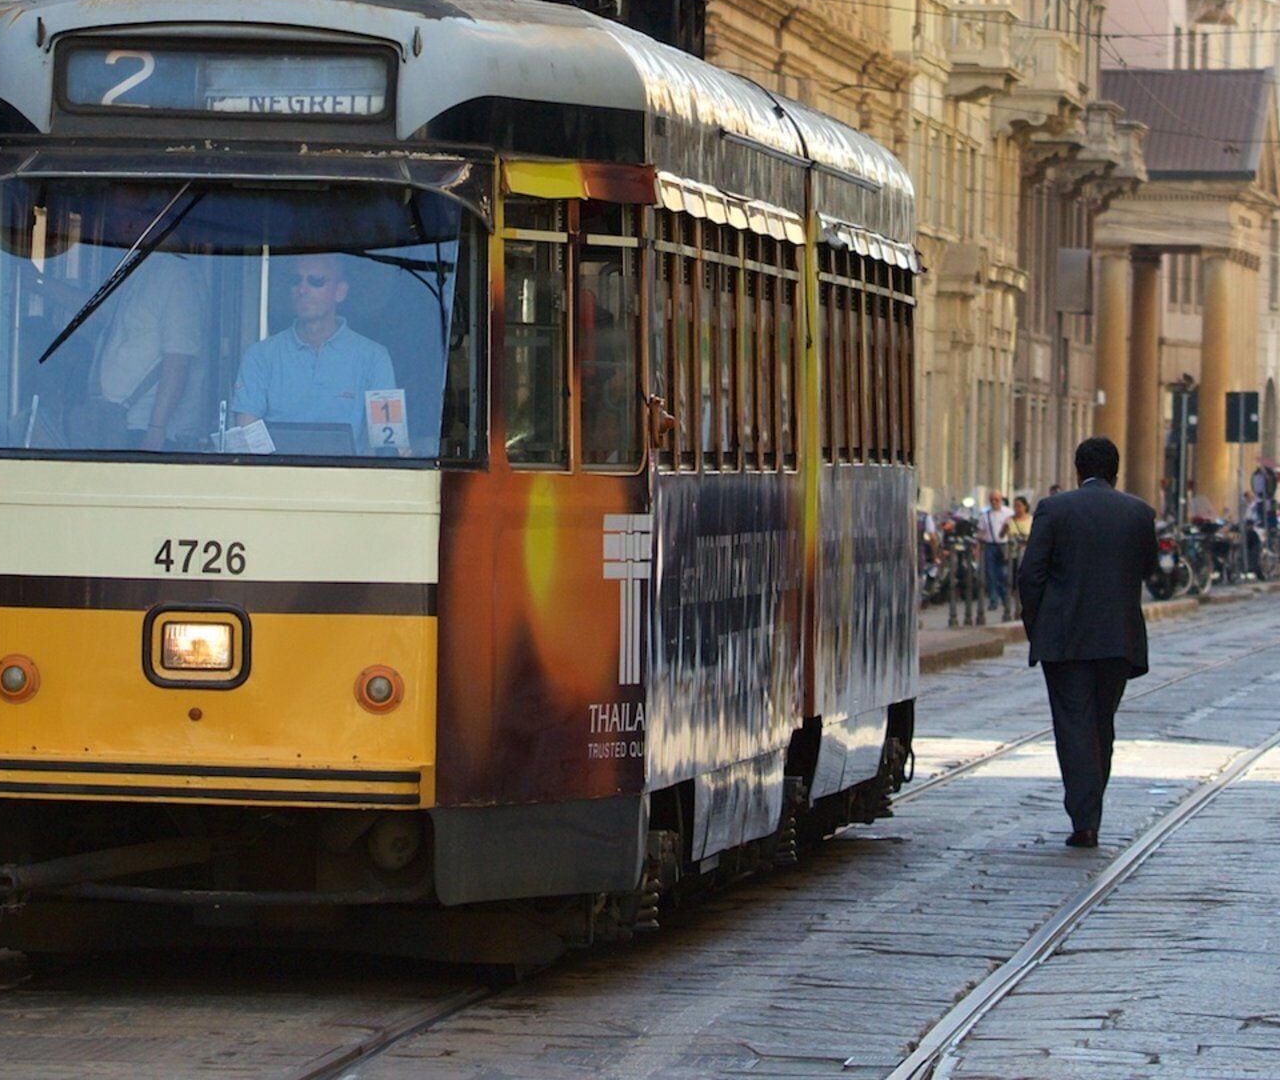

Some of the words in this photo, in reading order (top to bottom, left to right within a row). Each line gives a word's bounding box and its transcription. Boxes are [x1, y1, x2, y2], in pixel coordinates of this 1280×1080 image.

[101, 50, 156, 107] 2
[382, 426, 395, 445] 2
[154, 539, 246, 575] 4726
[588, 742, 627, 759] TRUSTED
